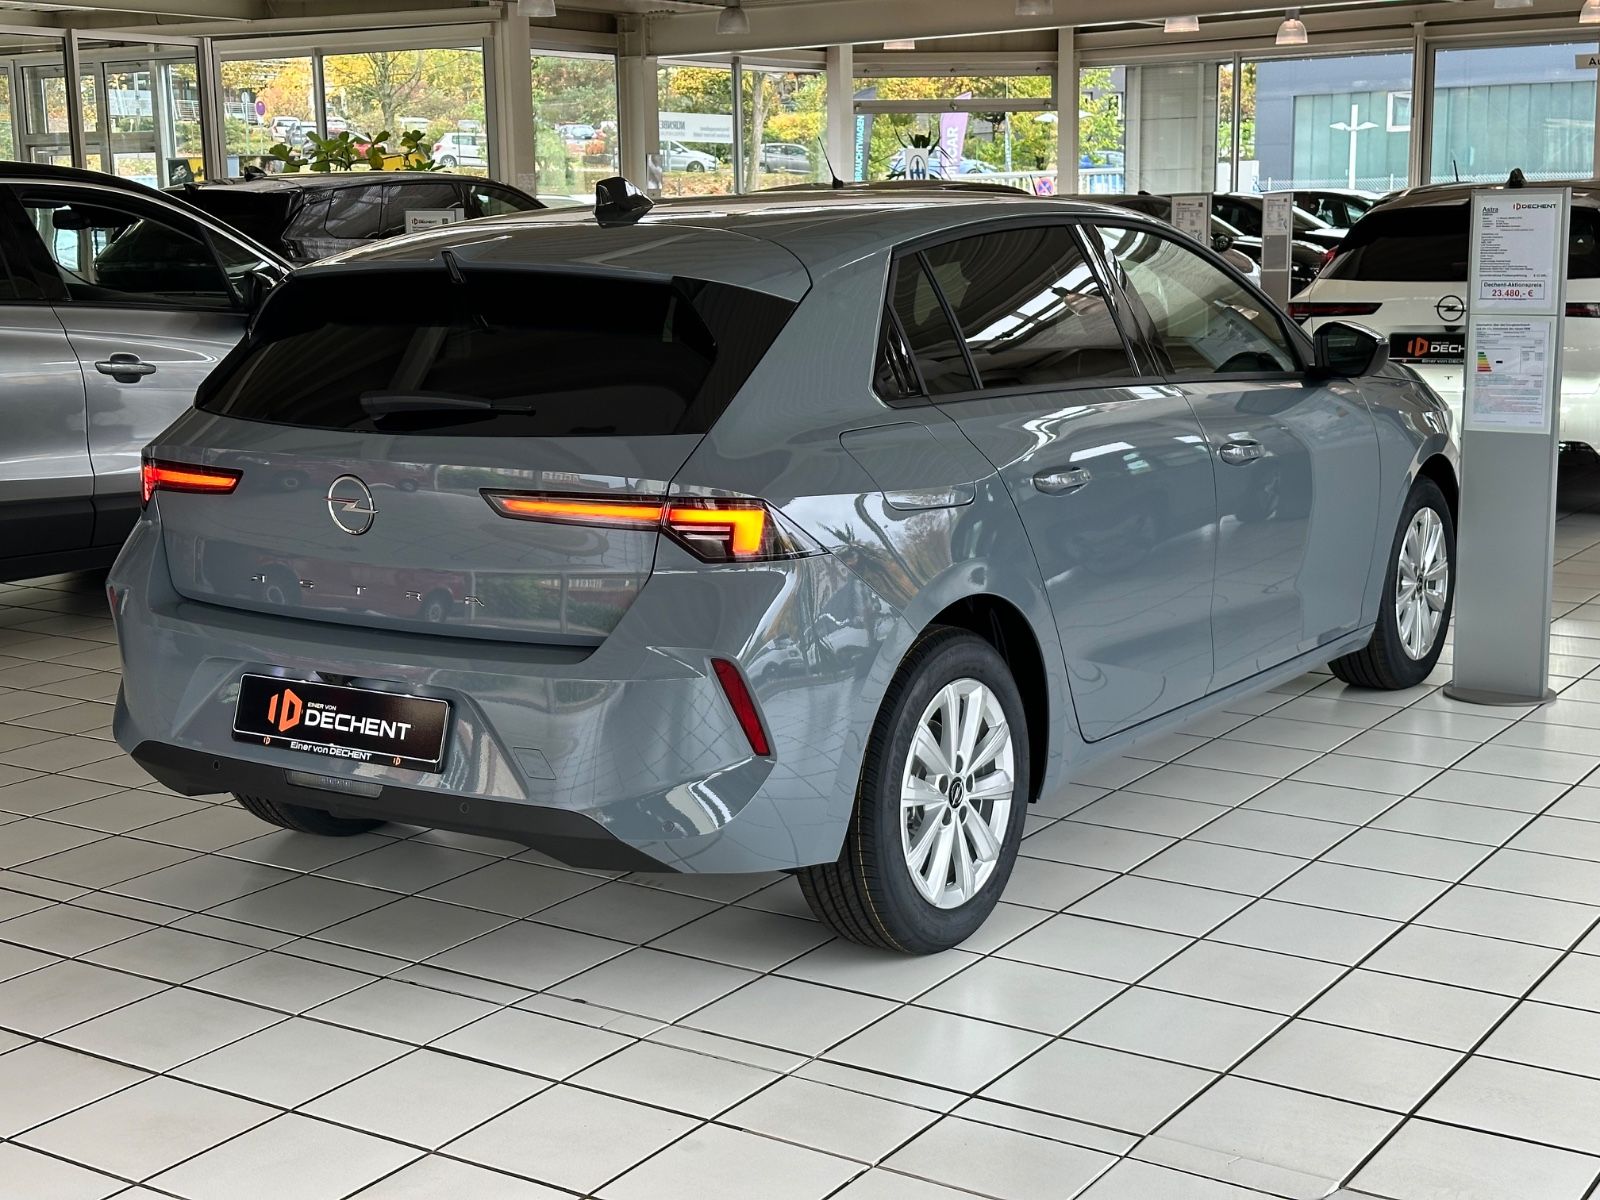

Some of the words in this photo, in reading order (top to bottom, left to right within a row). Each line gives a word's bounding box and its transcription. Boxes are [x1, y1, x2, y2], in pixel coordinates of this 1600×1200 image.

[1491, 289, 1526, 297] 23.480,-
[1527, 289, 1534, 297] €
[249, 574, 485, 607] ASTRA
[307, 701, 324, 709] EINER
[304, 709, 412, 740] DECHENT
[290, 741, 313, 751] Einer
[313, 745, 329, 754] von
[329, 747, 373, 761] DECHENT
